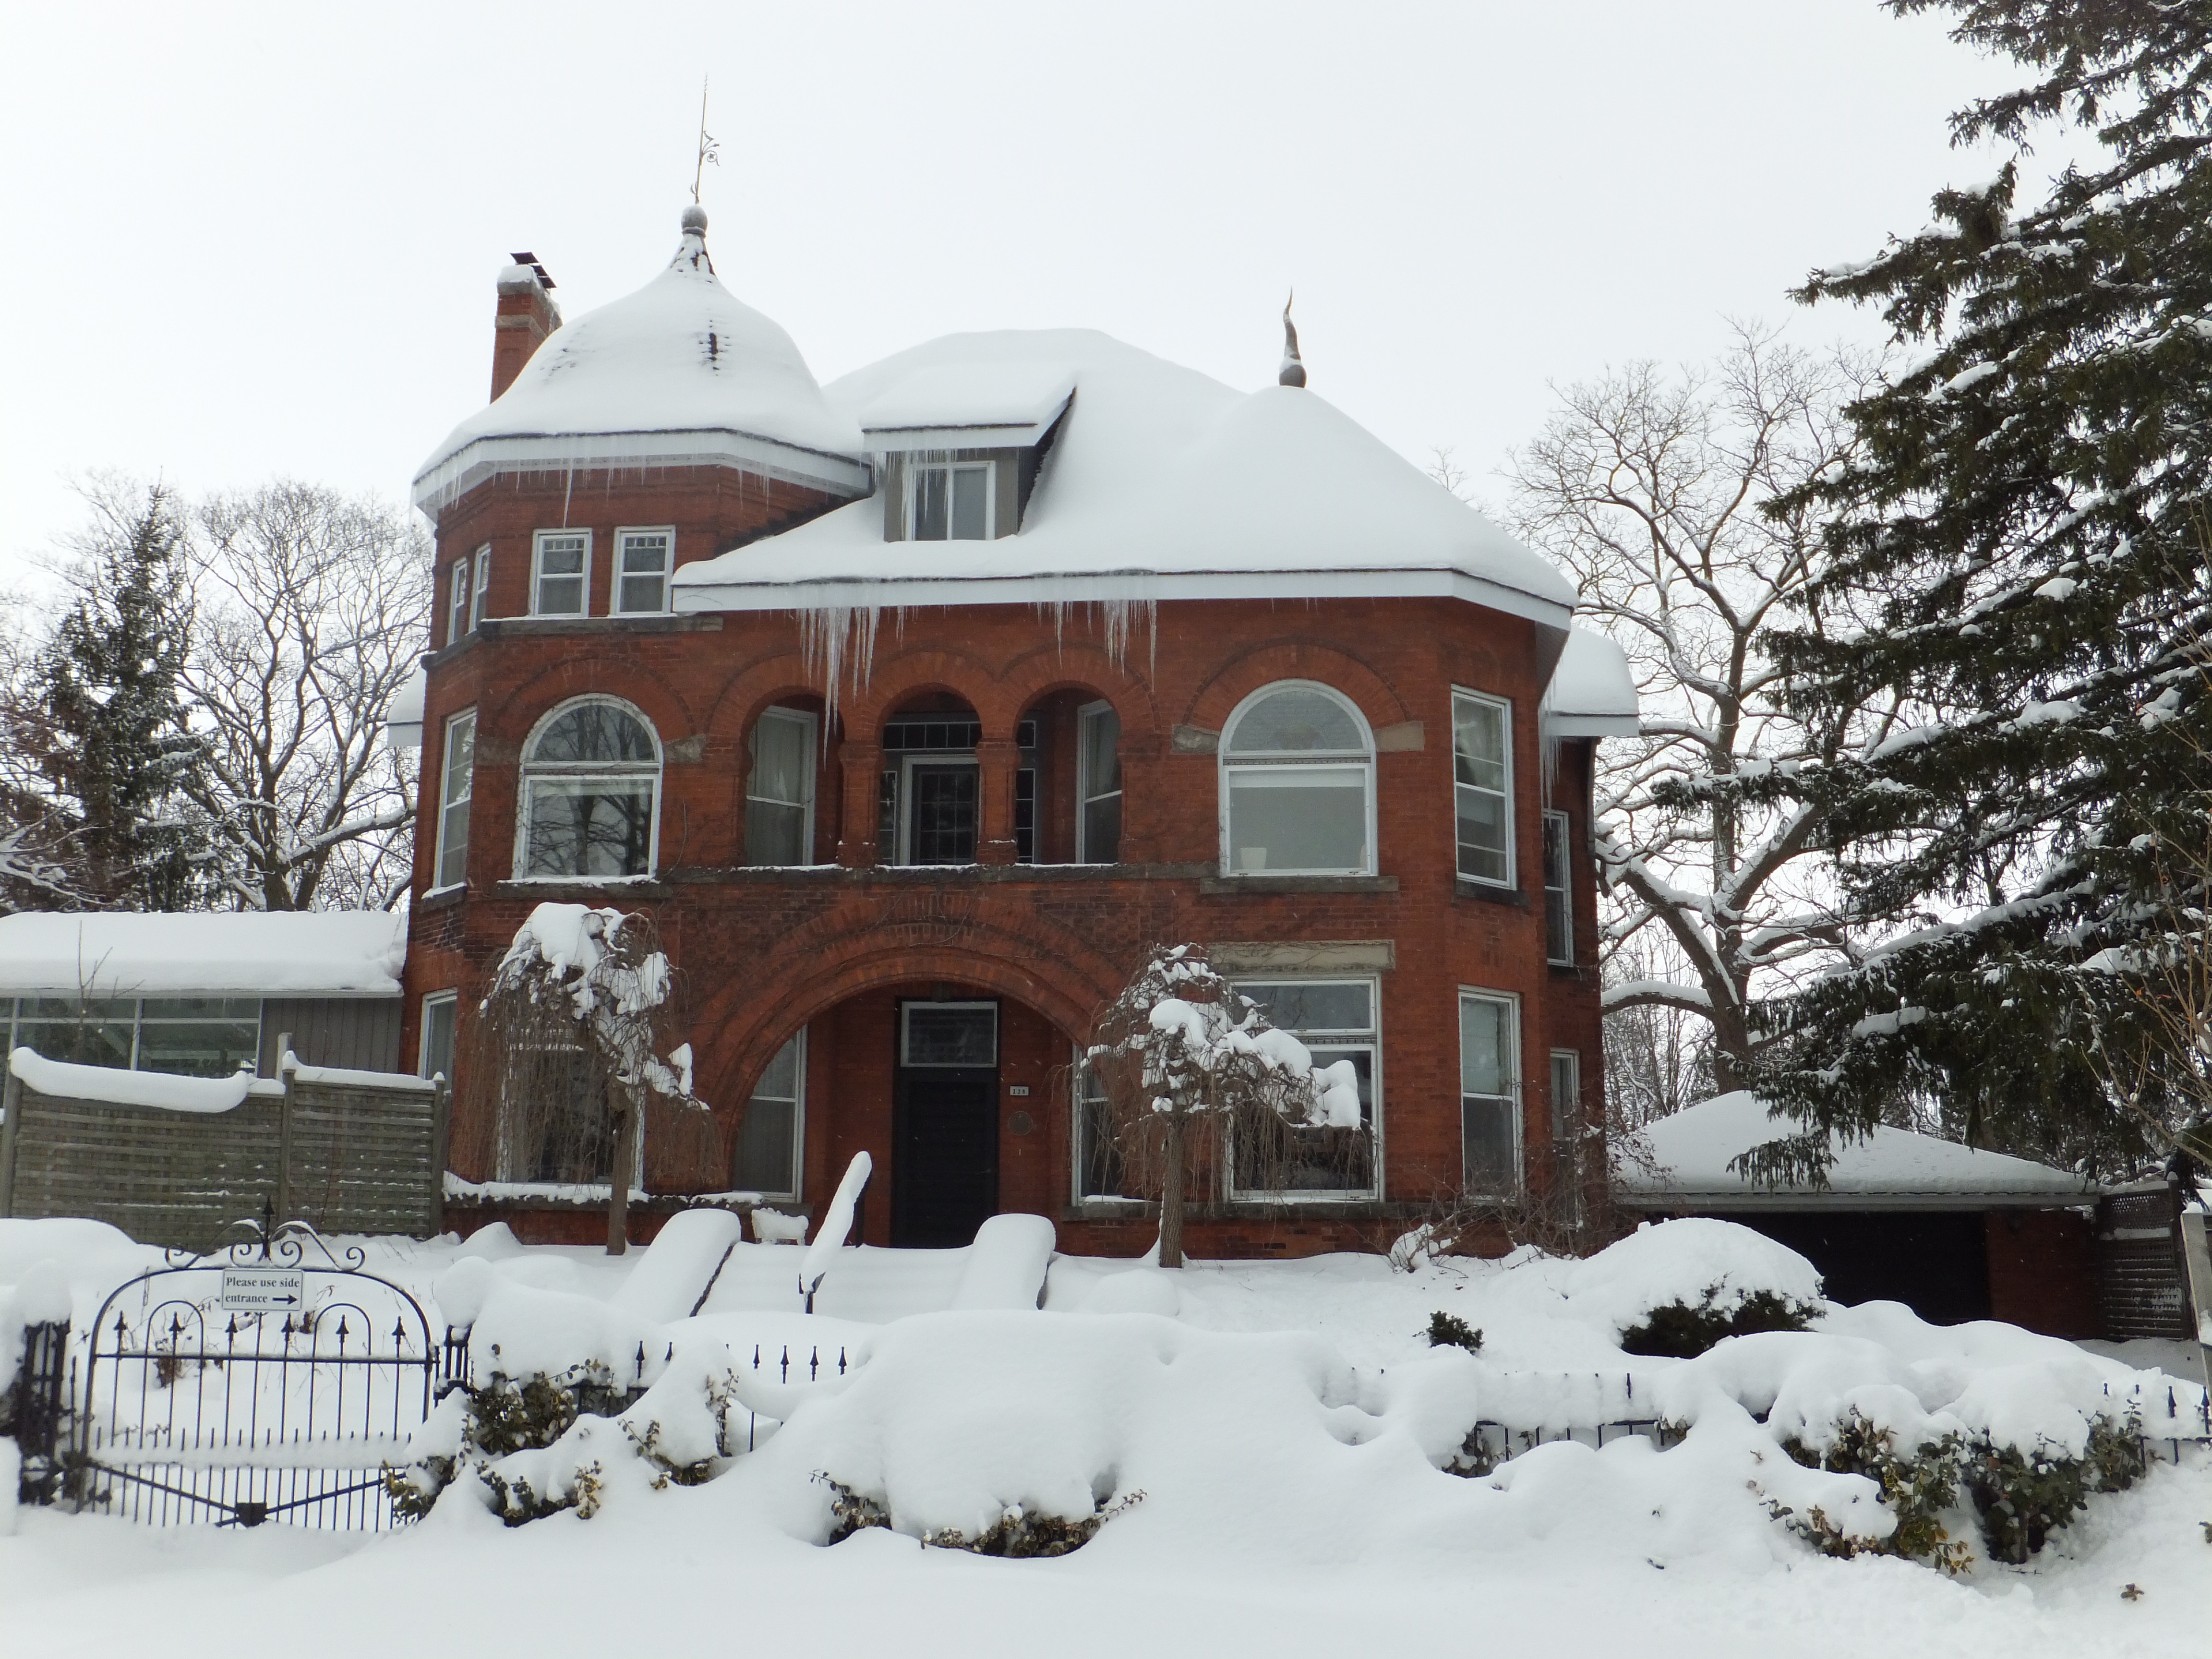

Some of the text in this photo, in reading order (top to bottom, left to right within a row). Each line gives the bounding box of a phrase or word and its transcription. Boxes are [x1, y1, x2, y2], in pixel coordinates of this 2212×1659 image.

[226, 1277, 300, 1287] Please use side
[226, 1294, 268, 1303] entrance
